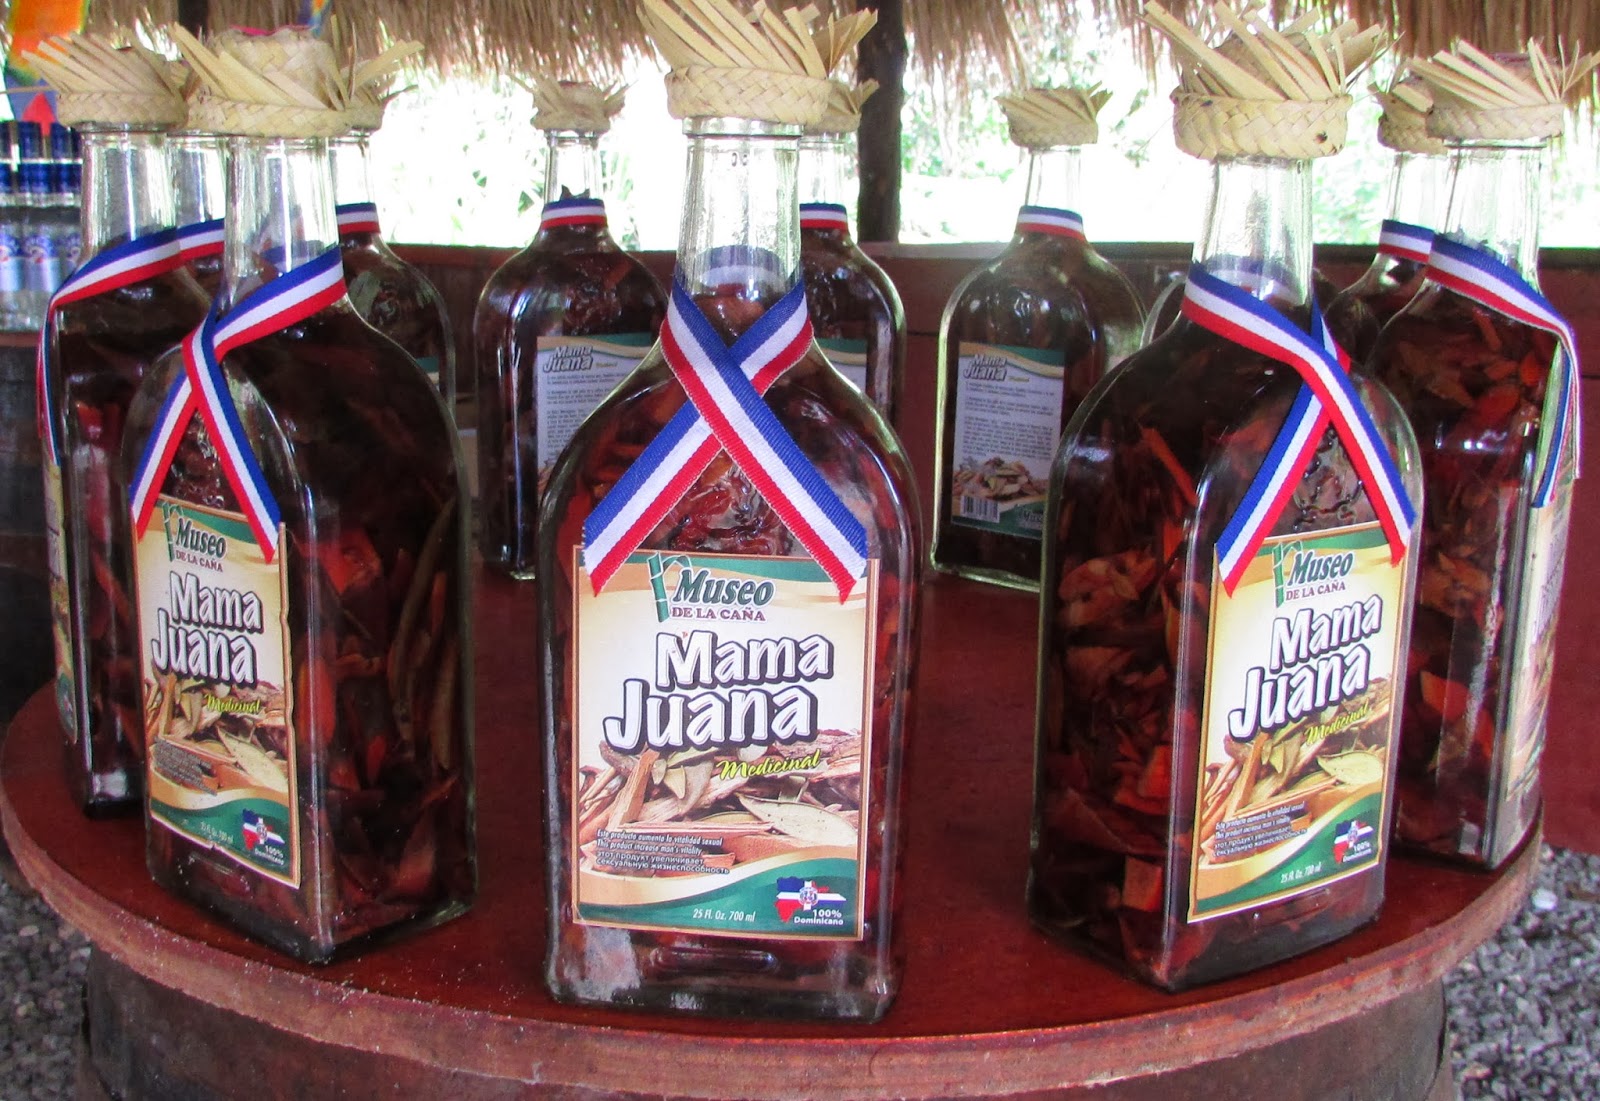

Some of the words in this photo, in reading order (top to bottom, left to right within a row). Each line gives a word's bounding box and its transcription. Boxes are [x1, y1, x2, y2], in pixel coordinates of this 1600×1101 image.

[554, 346, 593, 358] Mama
[543, 355, 593, 373] Juana
[963, 363, 1007, 381] Juana
[176, 518, 227, 558] Museo
[176, 550, 186, 560] DE
[187, 552, 198, 563] LA
[200, 557, 223, 572] CAÑA
[1287, 551, 1354, 586] Museo
[672, 568, 775, 606] Museo
[1286, 590, 1299, 601] DE
[1302, 587, 1315, 599] LA
[1317, 580, 1346, 595] CAÑA
[169, 570, 264, 634] Mama
[672, 607, 694, 619] DE
[696, 607, 716, 620] LA
[720, 607, 766, 622] CAÑA
[1269, 593, 1383, 673] Mama
[151, 607, 257, 690] Juana
[655, 630, 834, 691] Mama
[1227, 644, 1371, 742] Juana
[602, 678, 818, 753] Juana
[1303, 700, 1371, 745] Medicinal
[716, 749, 821, 780] Medicinal
[597, 829, 609, 838] Este
[610, 830, 636, 841] producto
[638, 833, 665, 842] aumenta
[666, 834, 673, 843] la
[674, 835, 701, 845] vitalidad
[701, 837, 723, 846] sexual
[597, 839, 608, 848] This
[610, 840, 633, 850] product
[634, 843, 658, 852] increase
[661, 845, 679, 853] man's
[681, 846, 702, 856] vitality
[1353, 841, 1370, 852] 100%
[616, 853, 649, 861] продукт
[692, 908, 703, 918] 25
[704, 909, 714, 919] Fl.
[715, 910, 727, 920] Oz.
[728, 911, 744, 921] 700
[745, 911, 756, 922] ml
[793, 916, 844, 926] Dominicano
[812, 909, 842, 918] 100%
